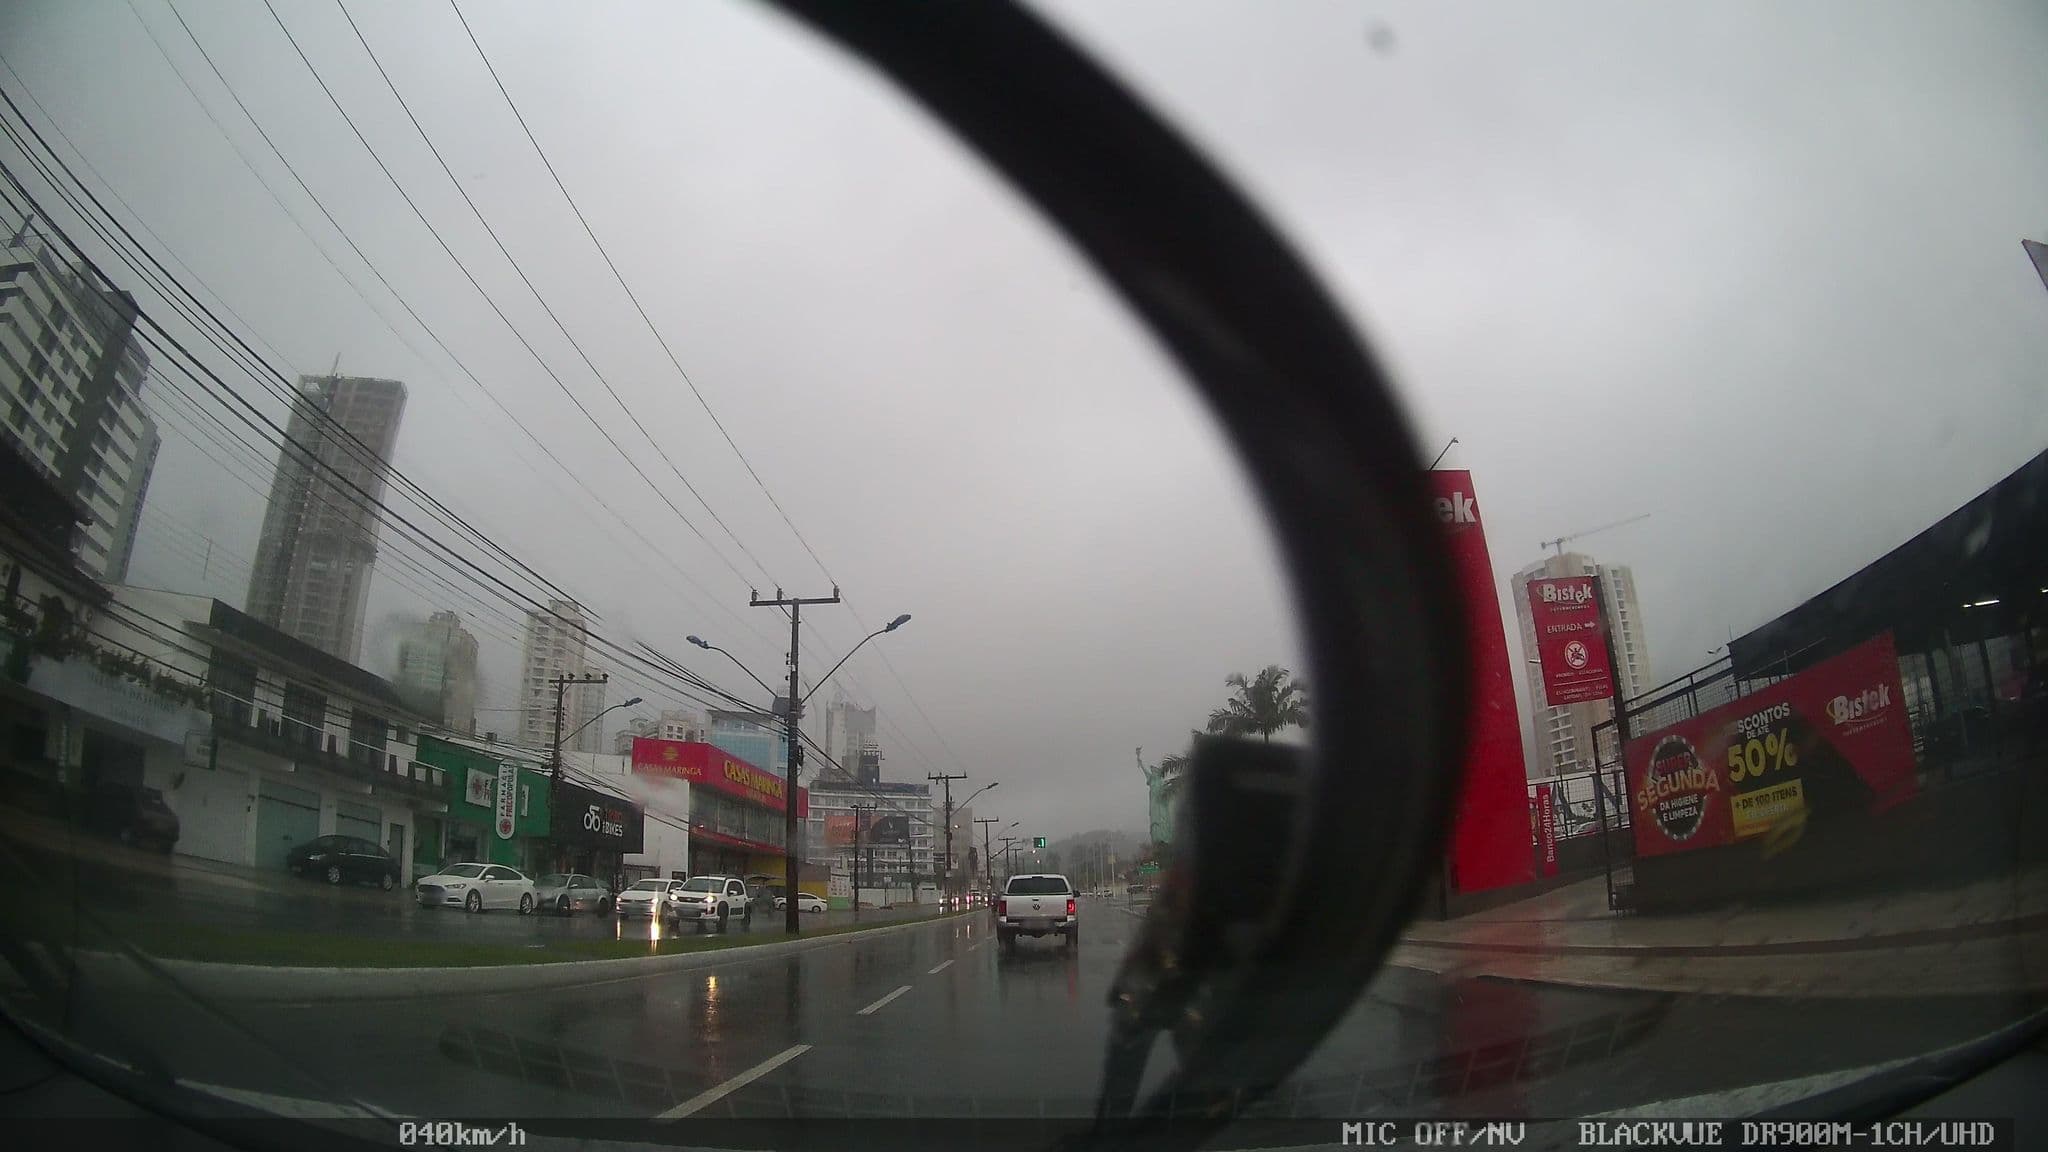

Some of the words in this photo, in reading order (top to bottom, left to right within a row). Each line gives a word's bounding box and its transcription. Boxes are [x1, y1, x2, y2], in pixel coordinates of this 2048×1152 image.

[1546, 623, 1583, 634] ENTRADA
[1736, 702, 1791, 733] SCONTOS
[1746, 729, 1757, 740] DE
[1727, 728, 1798, 783] 50%
[724, 759, 750, 786] CASAS
[1637, 768, 1721, 811] SEGUNDA
[1660, 799, 1670, 812] DA
[1671, 793, 1699, 809] HIGIENE
[1669, 806, 1698, 821] LIMPEZA
[1742, 798, 1754, 809] DE
[1542, 793, 1556, 863] Banco24Horas
